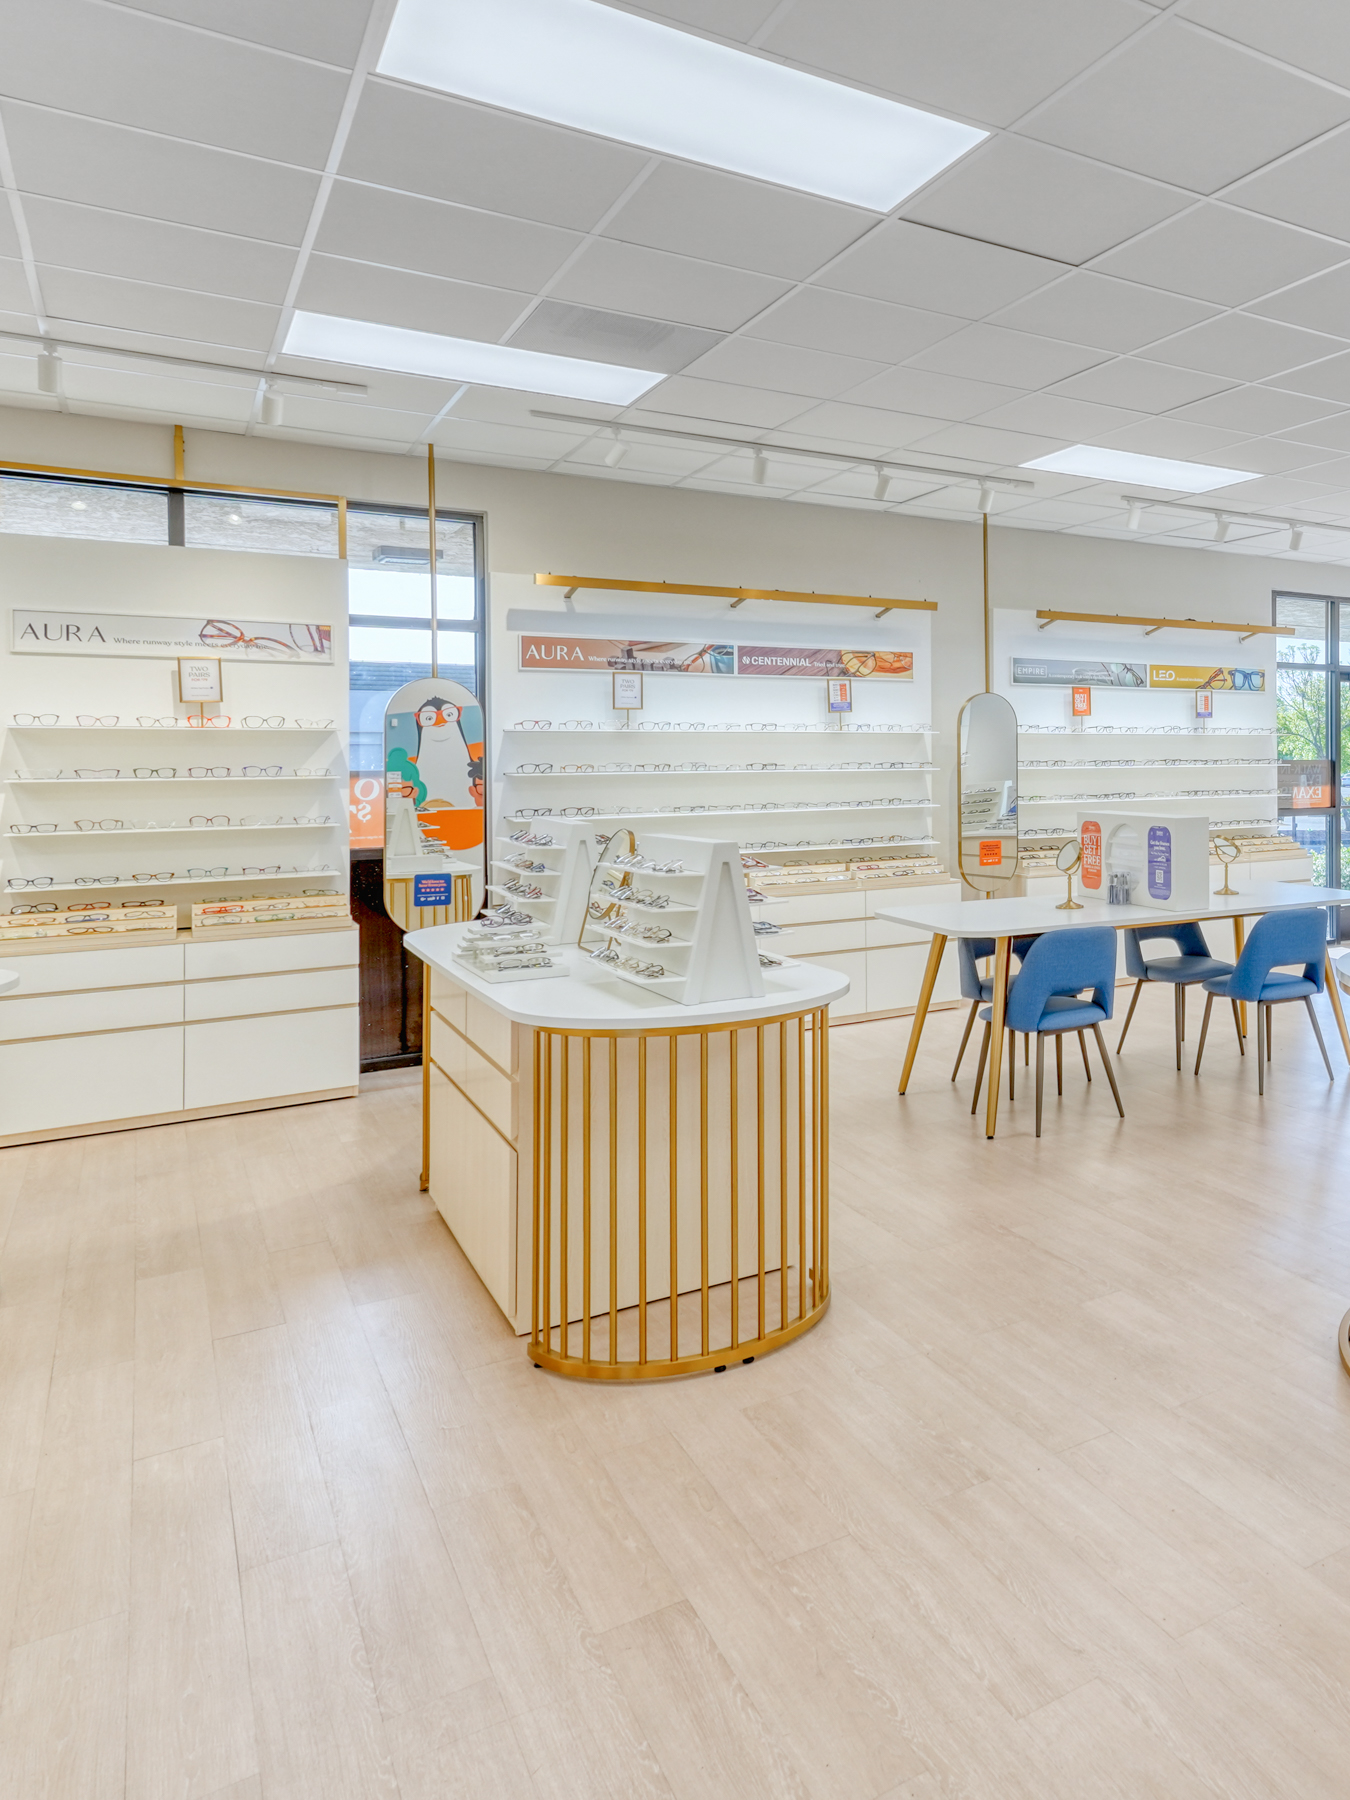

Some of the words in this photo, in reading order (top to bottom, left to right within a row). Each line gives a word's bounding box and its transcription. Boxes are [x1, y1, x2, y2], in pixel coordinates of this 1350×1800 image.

[20, 622, 107, 643] AURA
[113, 637, 141, 645] Where
[143, 638, 173, 648] runway
[173, 640, 193, 648] style
[526, 644, 584, 661] AURA
[588, 655, 607, 663] Where
[751, 656, 812, 667] CENTENNIAL
[1017, 667, 1045, 675] EMPIRE
[1153, 670, 1175, 681] LEO
[1083, 835, 1097, 846] BUY
[1083, 845, 1096, 855] GET
[1083, 854, 1101, 866] FREE
